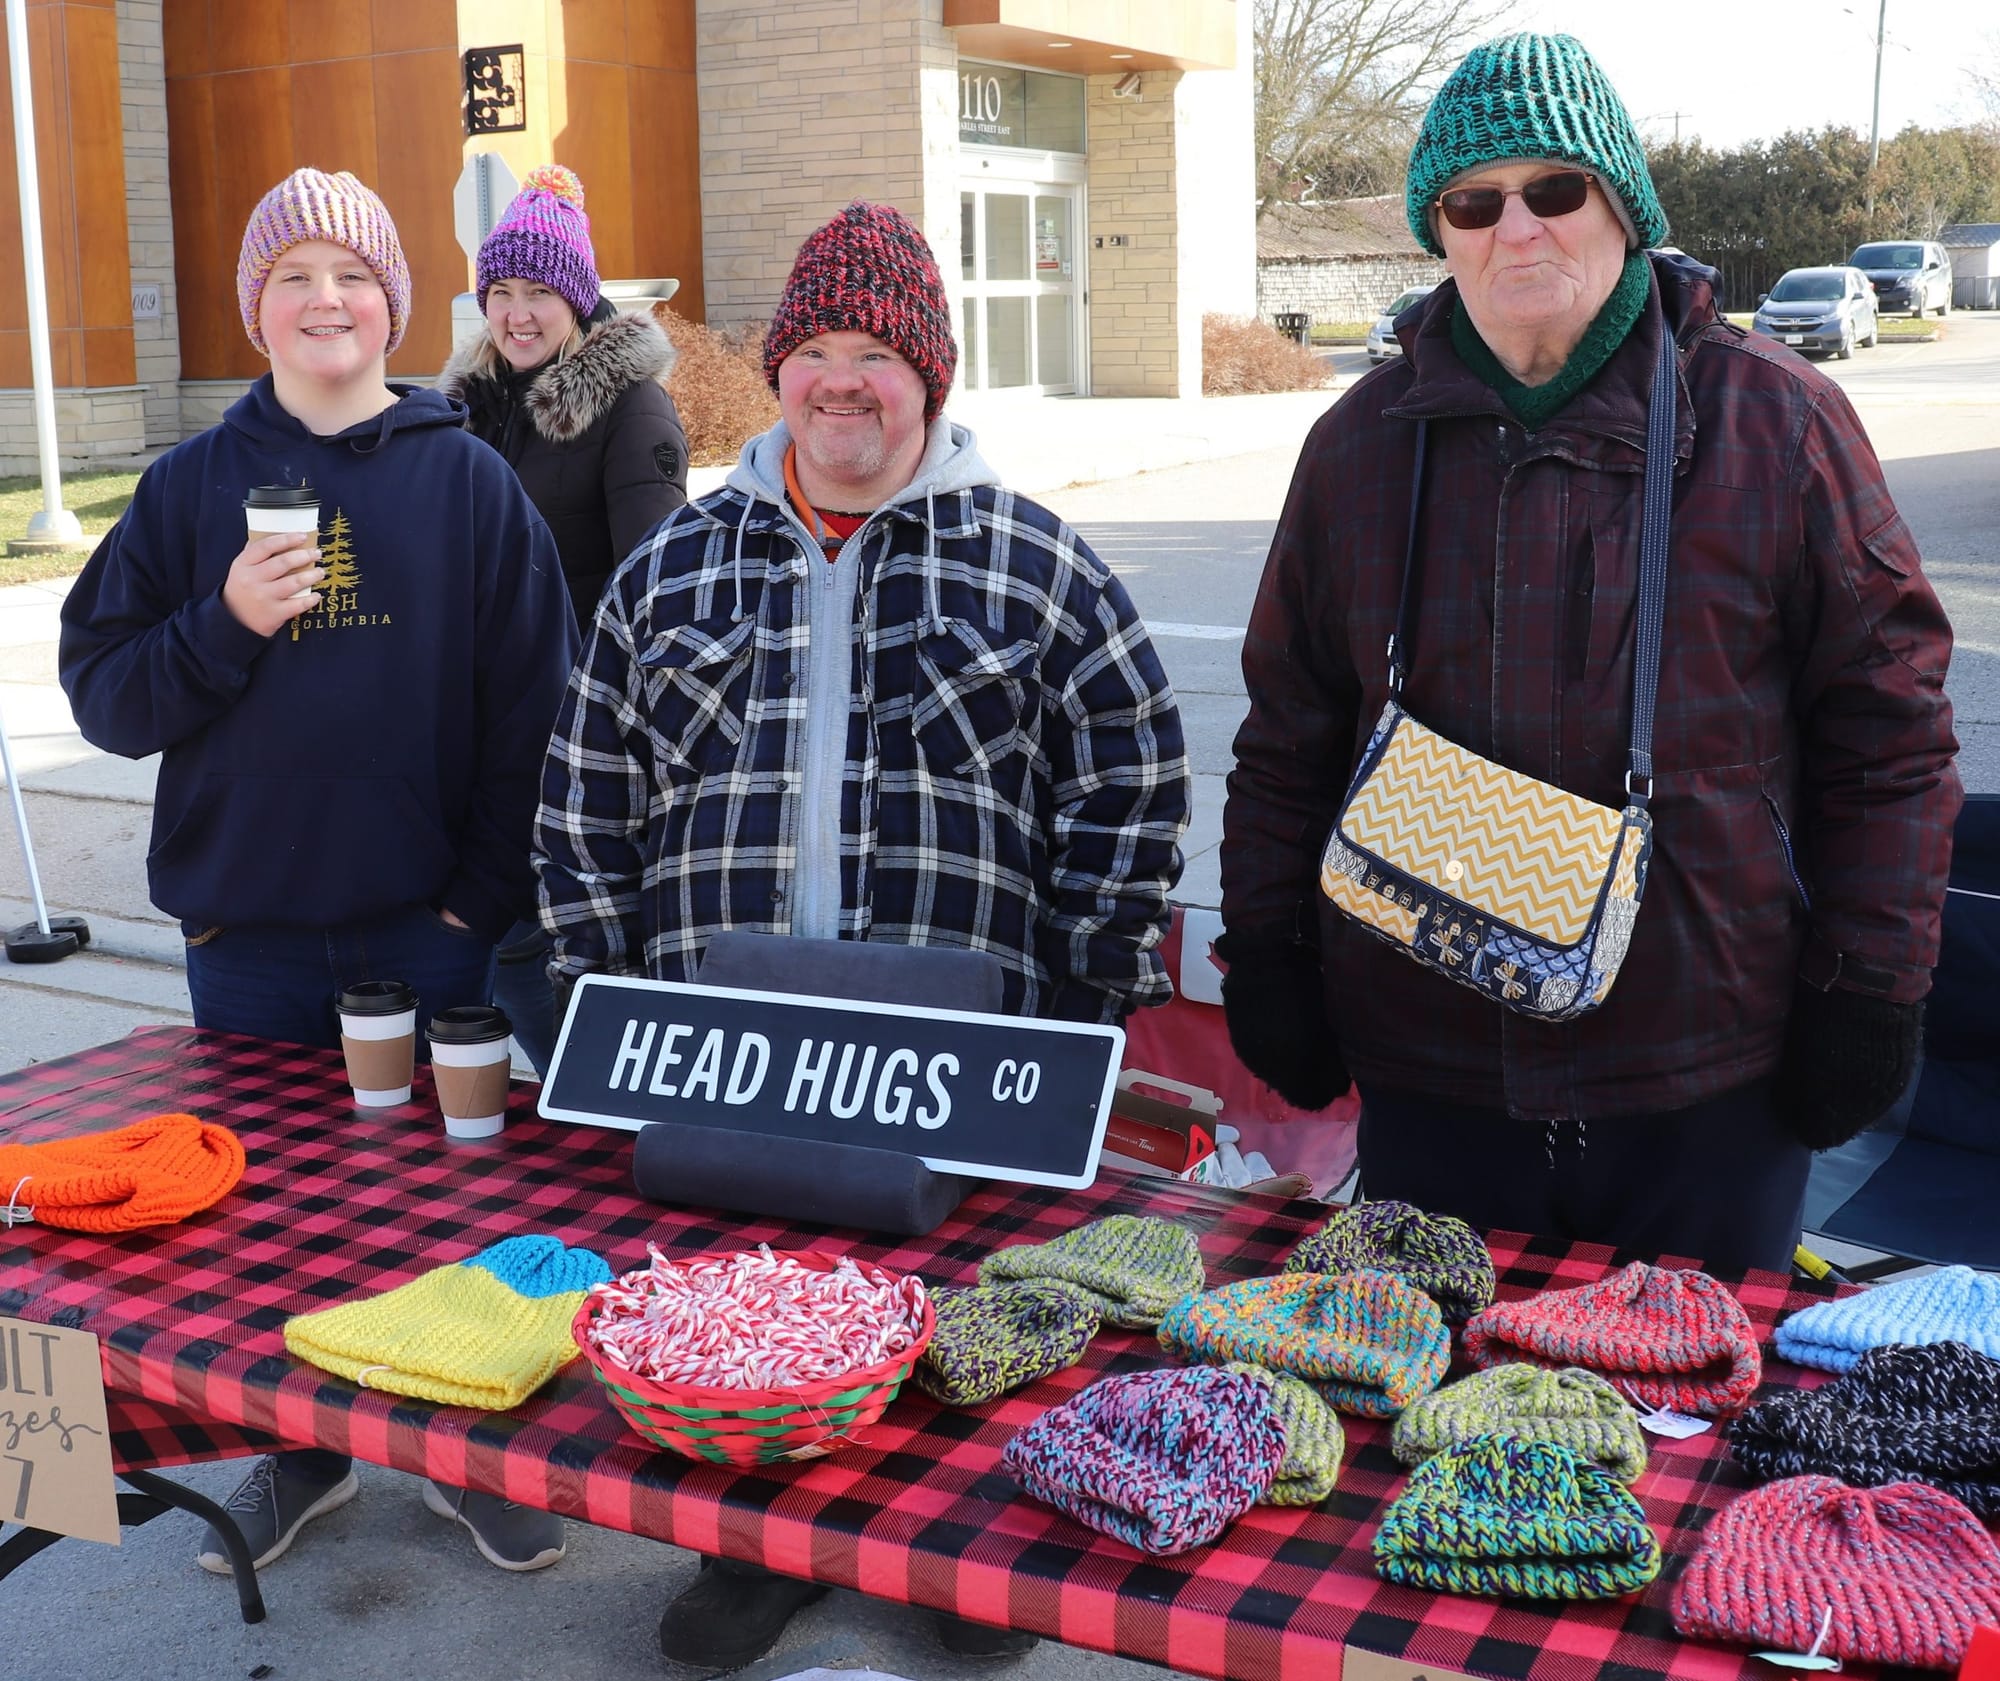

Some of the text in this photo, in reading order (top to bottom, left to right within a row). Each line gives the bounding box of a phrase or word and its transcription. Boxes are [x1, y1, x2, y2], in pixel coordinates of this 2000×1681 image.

[961, 73, 1001, 122] 110
[977, 123, 997, 134] STREET
[997, 125, 1011, 135] EAST
[308, 592, 358, 614] ISH
[291, 614, 391, 630] COLUMBIA
[608, 1019, 1041, 1130] HEAD HUGS CO
[1138, 1137, 1156, 1152] Tims
[3, 1455, 34, 1520] 7
